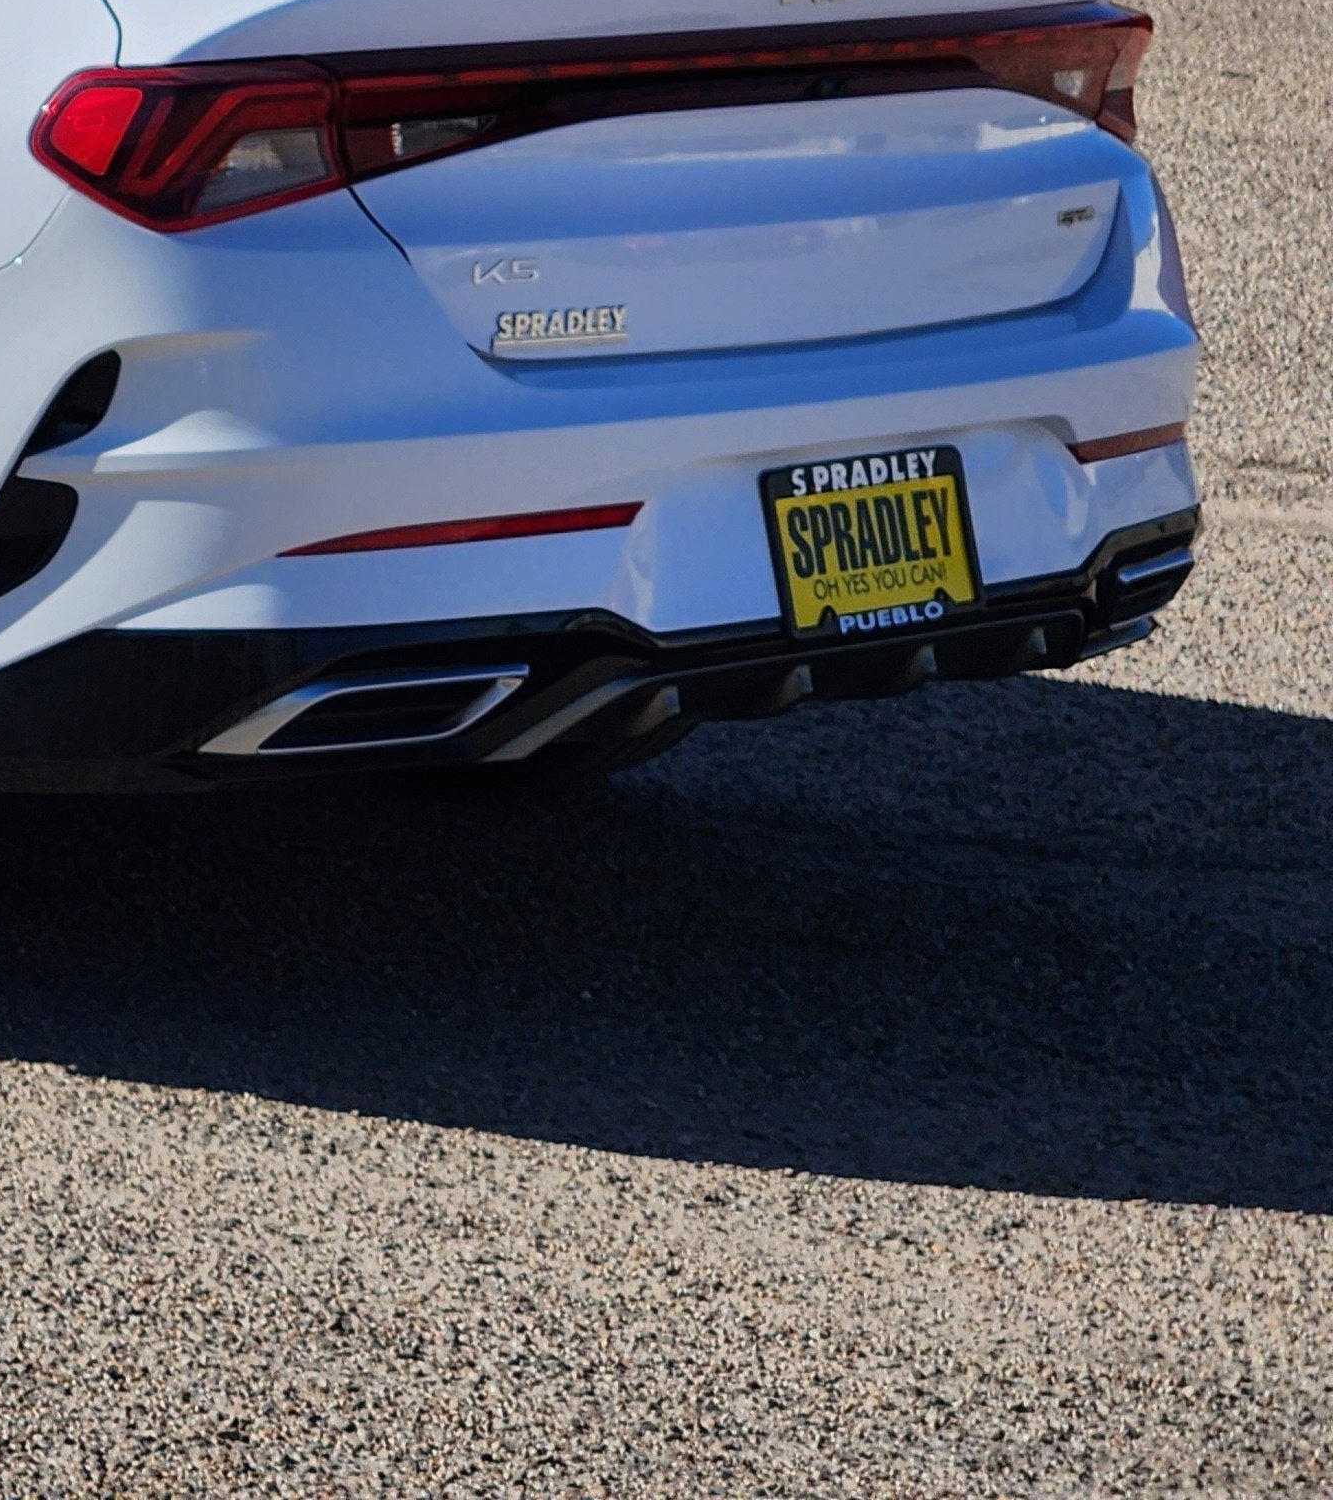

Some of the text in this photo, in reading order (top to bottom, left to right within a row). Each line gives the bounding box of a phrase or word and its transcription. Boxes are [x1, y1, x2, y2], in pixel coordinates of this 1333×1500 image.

[472, 259, 540, 285] K5
[496, 304, 629, 339] SPRADLEY
[787, 487, 952, 579] SPRADLEY
[814, 578, 841, 600] OH
[845, 574, 871, 595] YES
[875, 569, 907, 592] YOU
[840, 601, 944, 634] PUEBLO
